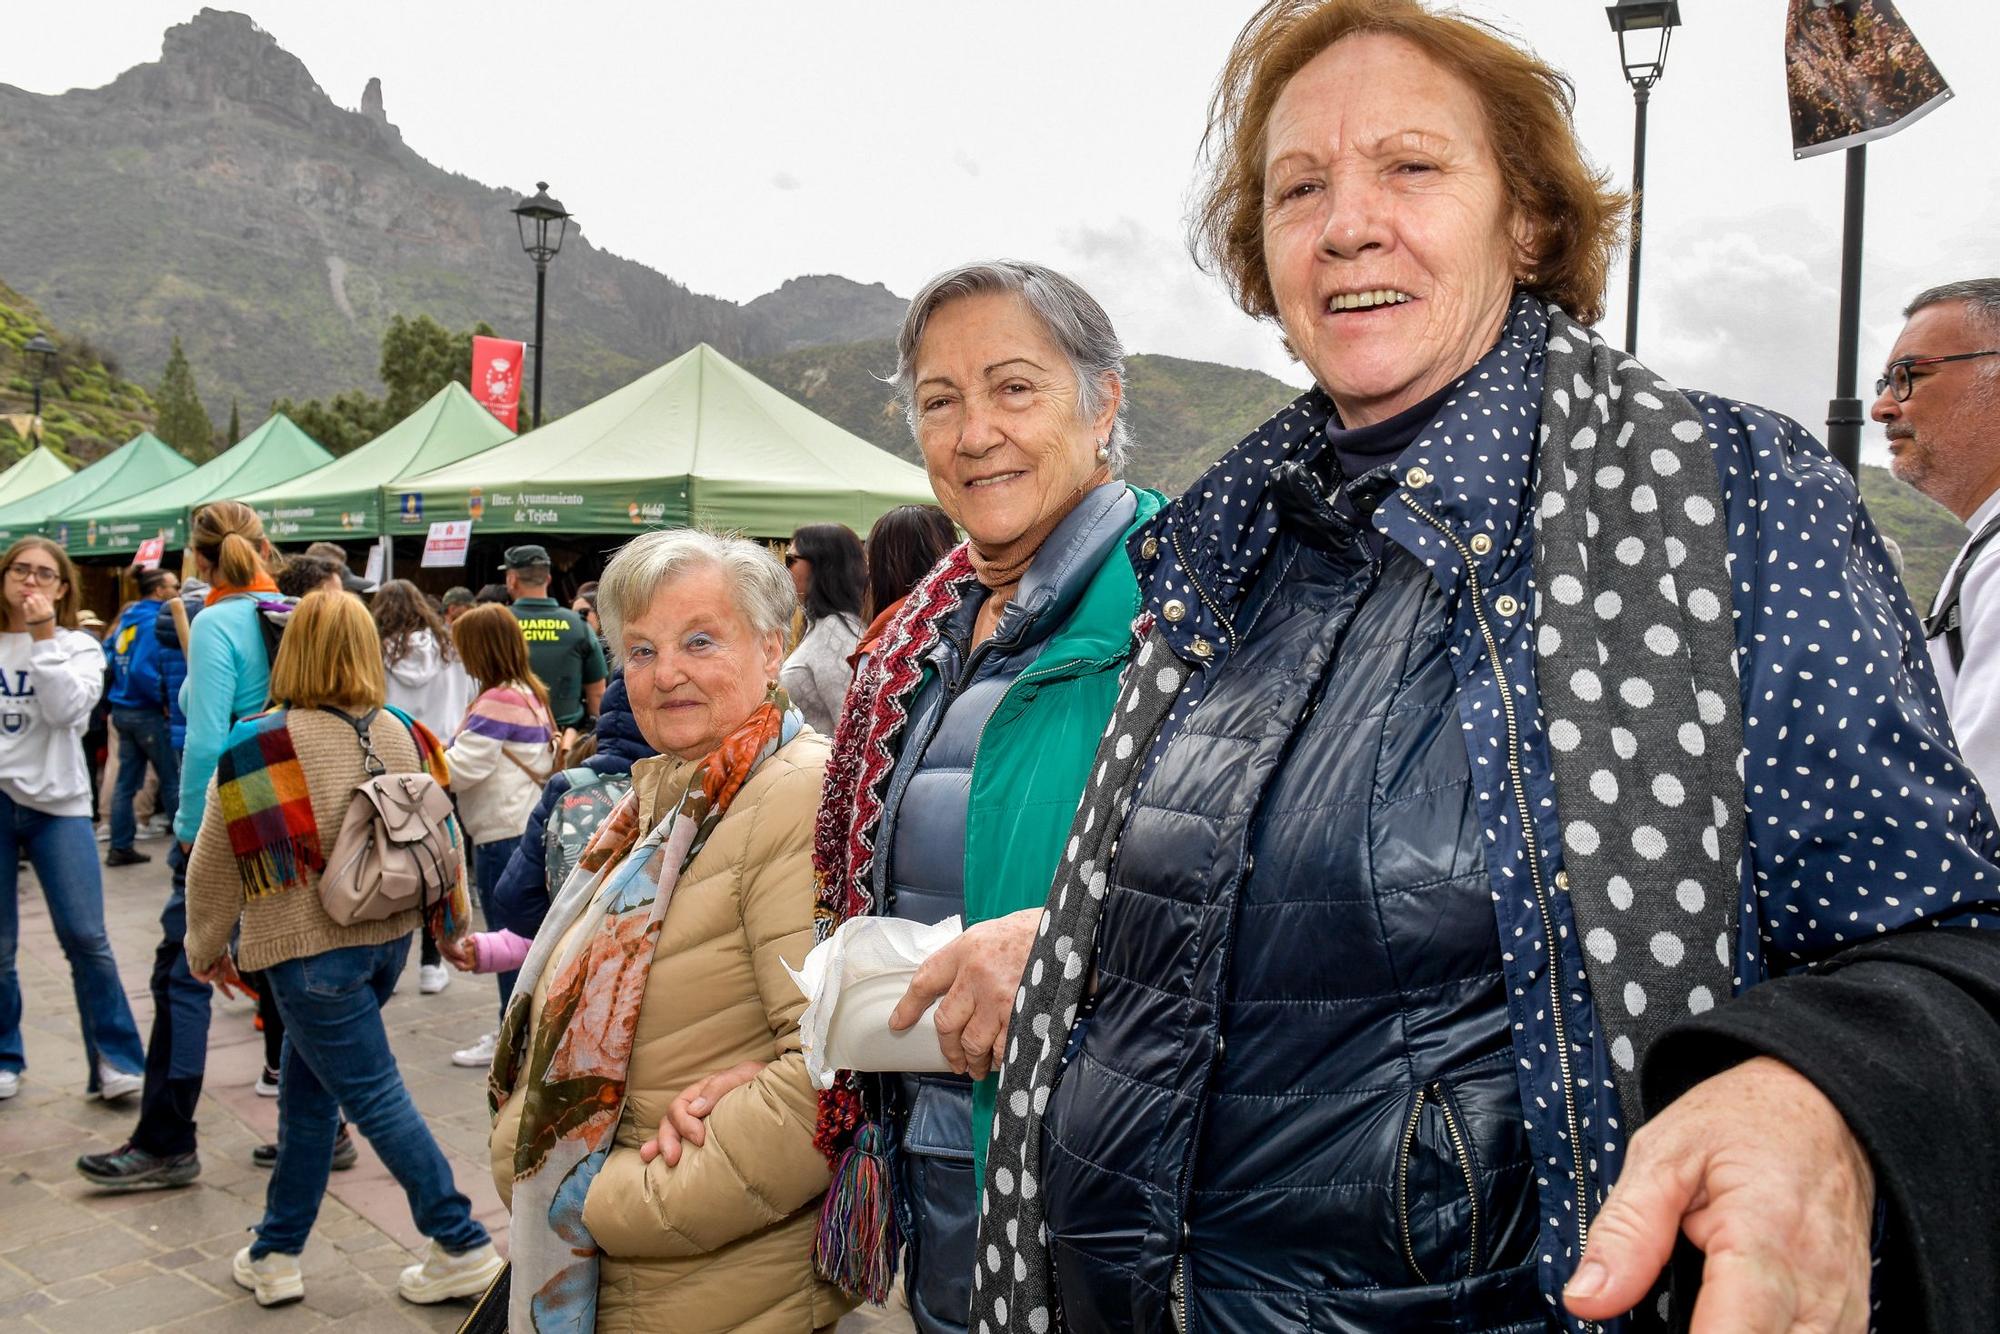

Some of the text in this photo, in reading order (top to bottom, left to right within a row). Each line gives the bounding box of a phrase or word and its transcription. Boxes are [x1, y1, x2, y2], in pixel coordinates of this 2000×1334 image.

[517, 491, 584, 507] Ayuntamiento
[514, 509, 558, 525] de Tejeda
[518, 619, 570, 631] UARDIA
[523, 629, 560, 641] CIVIL
